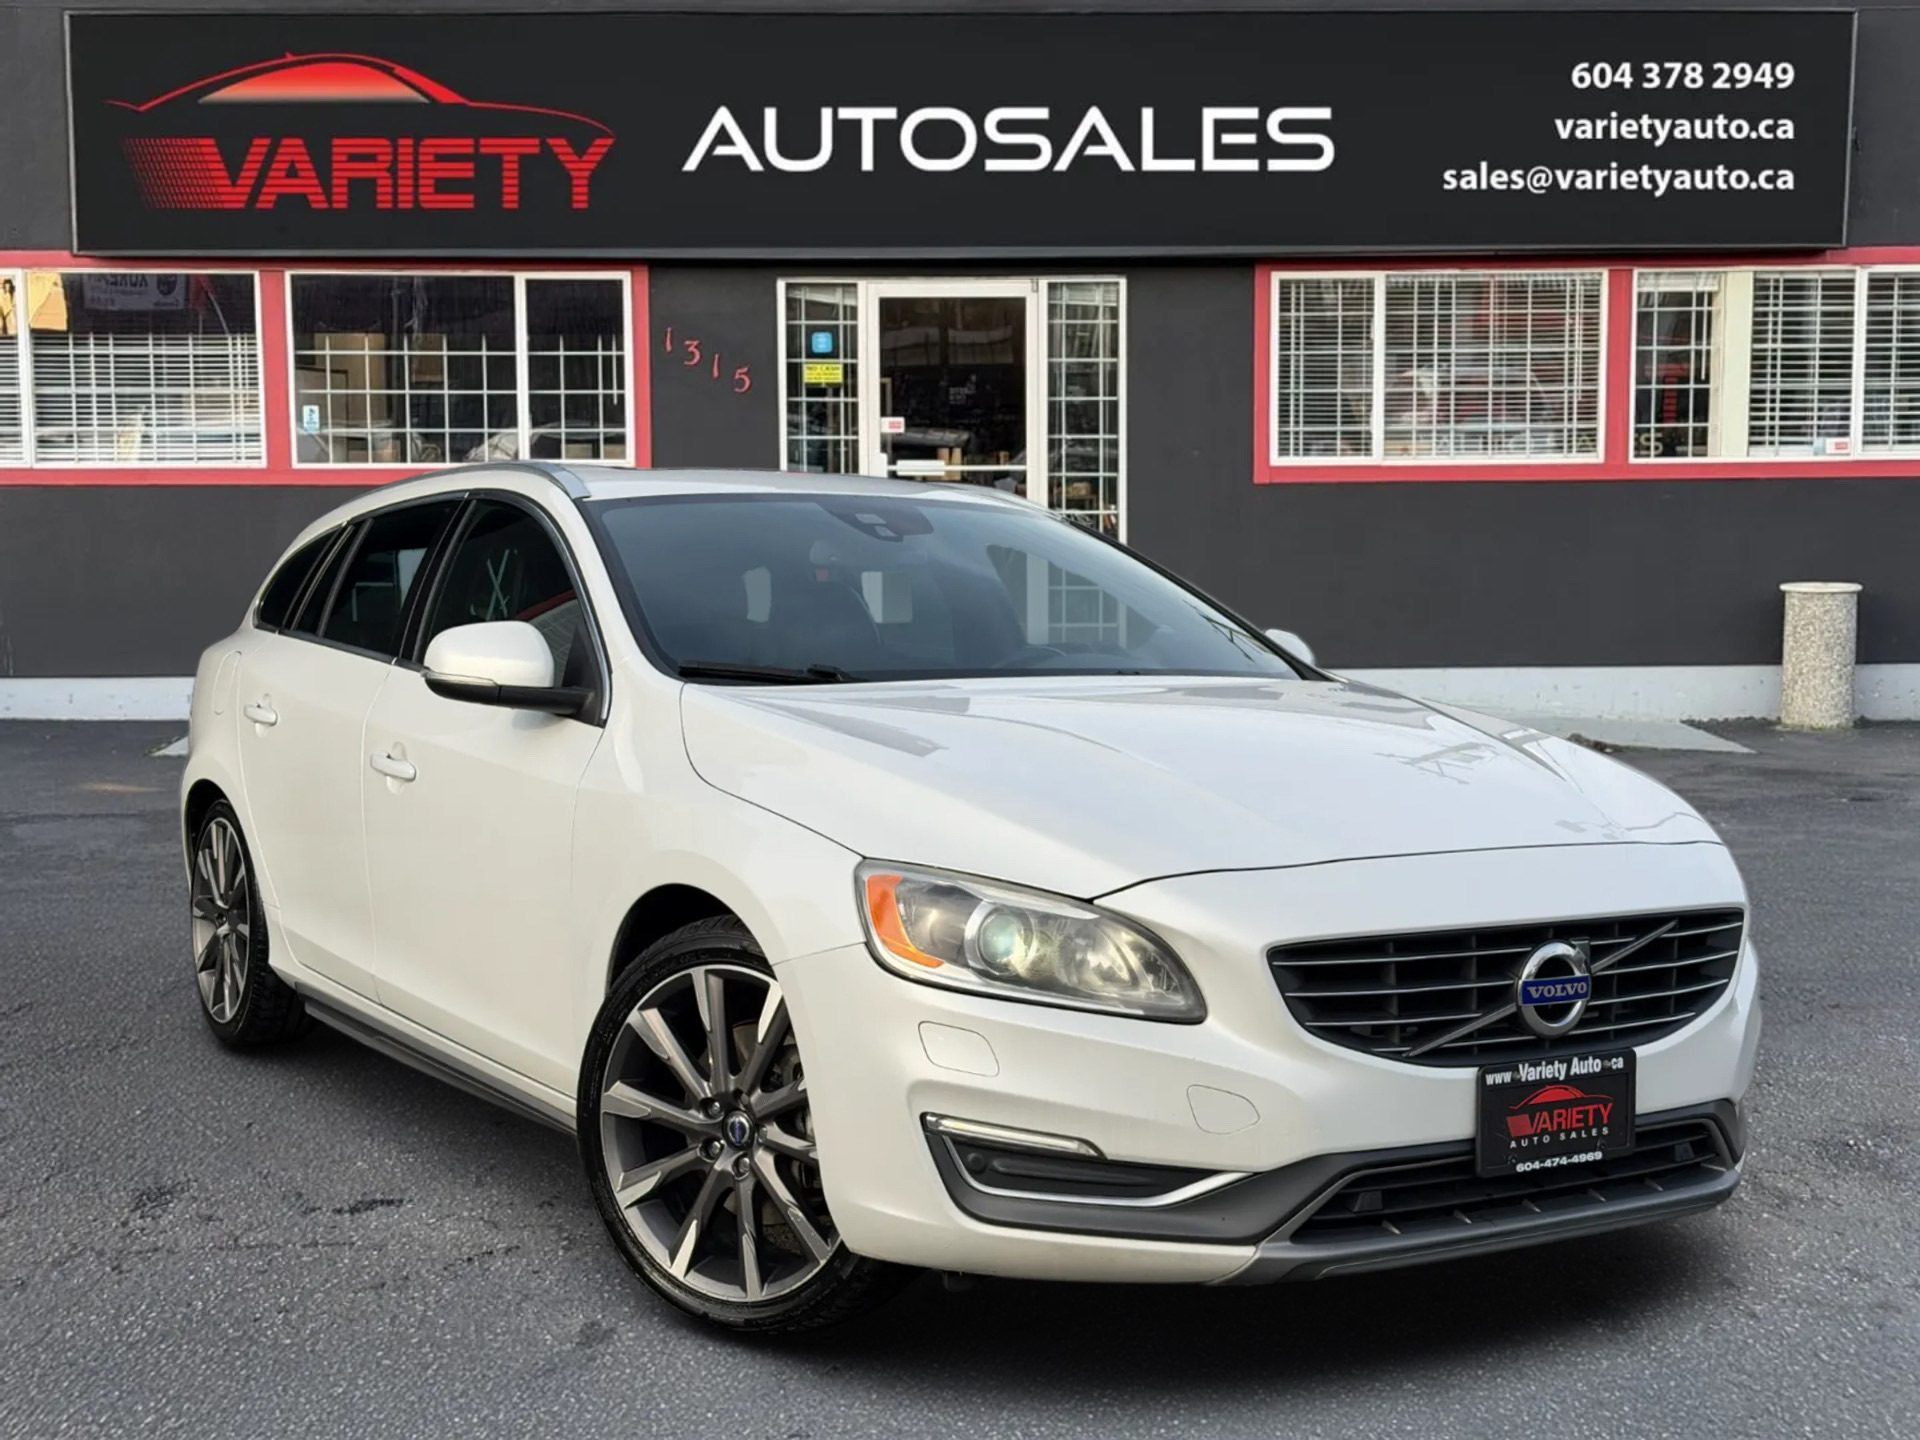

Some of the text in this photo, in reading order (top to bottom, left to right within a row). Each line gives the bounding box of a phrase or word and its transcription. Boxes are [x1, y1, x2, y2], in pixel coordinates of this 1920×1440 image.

[1571, 61, 1795, 89] 604 378 2949
[681, 105, 1335, 173] AUTOSALES
[1554, 111, 1795, 148] varietyauto.ca
[126, 136, 615, 211] VARIETY
[1442, 161, 1795, 198] sales@varietyauto.ca
[1526, 982, 1587, 998] VOLVO
[1570, 1056, 1602, 1076] Auto
[1506, 1103, 1613, 1137] VARIETY
[1509, 1126, 1609, 1149] AUTO SALES
[1516, 1151, 1603, 1173] 604-474-4969
